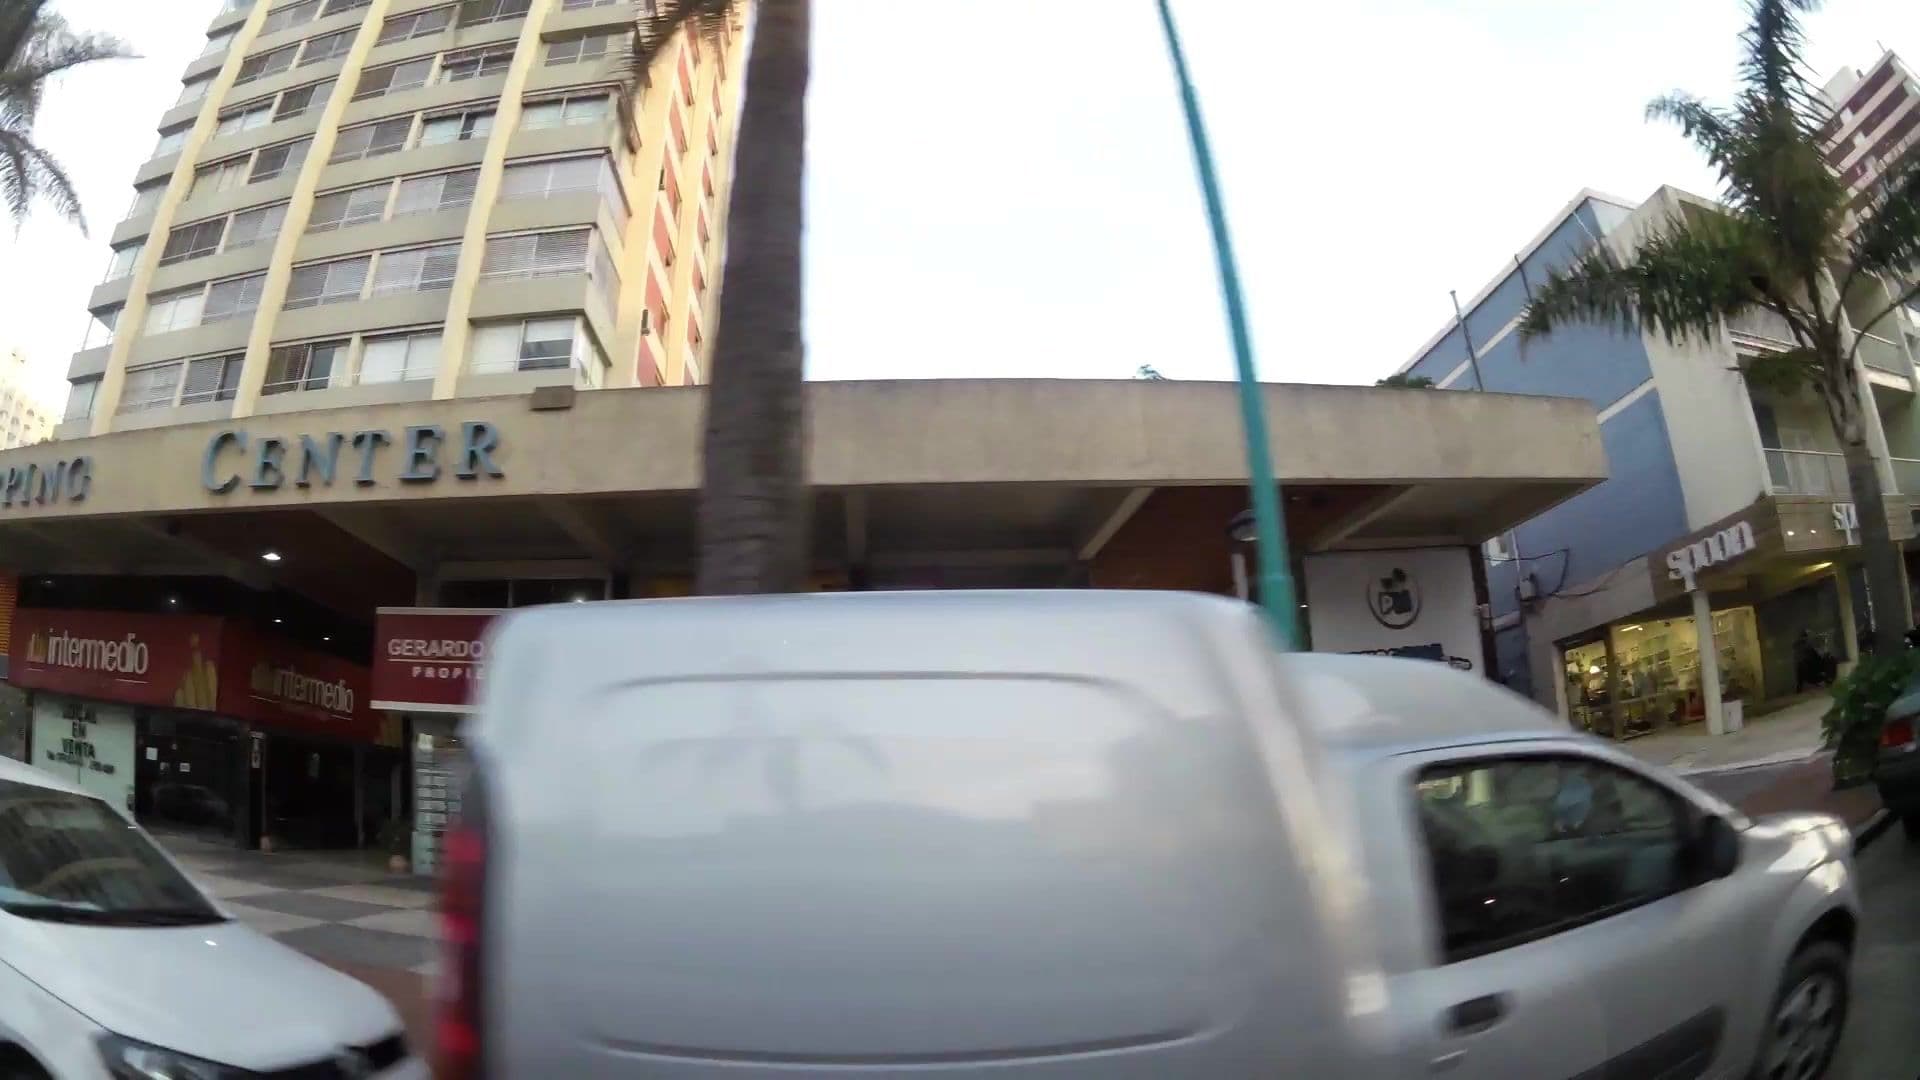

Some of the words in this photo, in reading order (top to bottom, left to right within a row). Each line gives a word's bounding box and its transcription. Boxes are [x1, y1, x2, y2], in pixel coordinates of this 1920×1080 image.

[203, 421, 504, 493] CENTER
[1665, 520, 1756, 593] spoon
[47, 628, 150, 675] intermedio
[387, 638, 485, 658] GERARDO
[272, 665, 354, 714] intermedio
